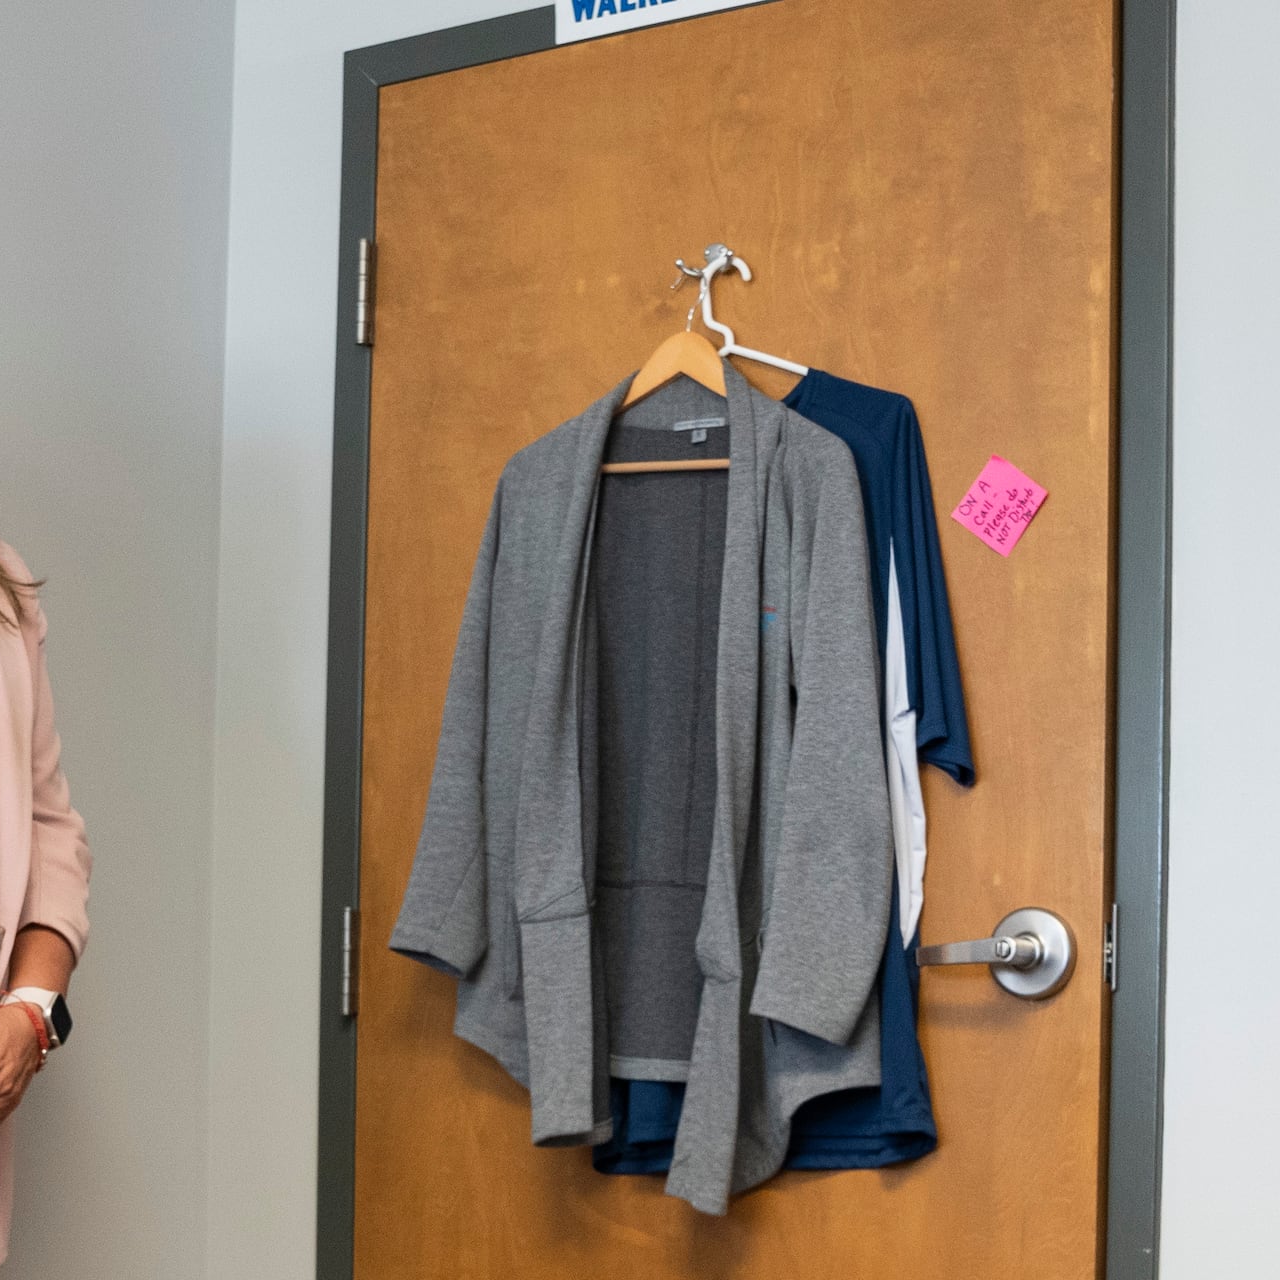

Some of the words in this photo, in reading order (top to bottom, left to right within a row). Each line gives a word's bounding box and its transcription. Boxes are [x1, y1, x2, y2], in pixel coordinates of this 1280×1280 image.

[958, 493, 977, 516] ON
[974, 500, 994, 526] Call
[996, 523, 1011, 545] NOT
